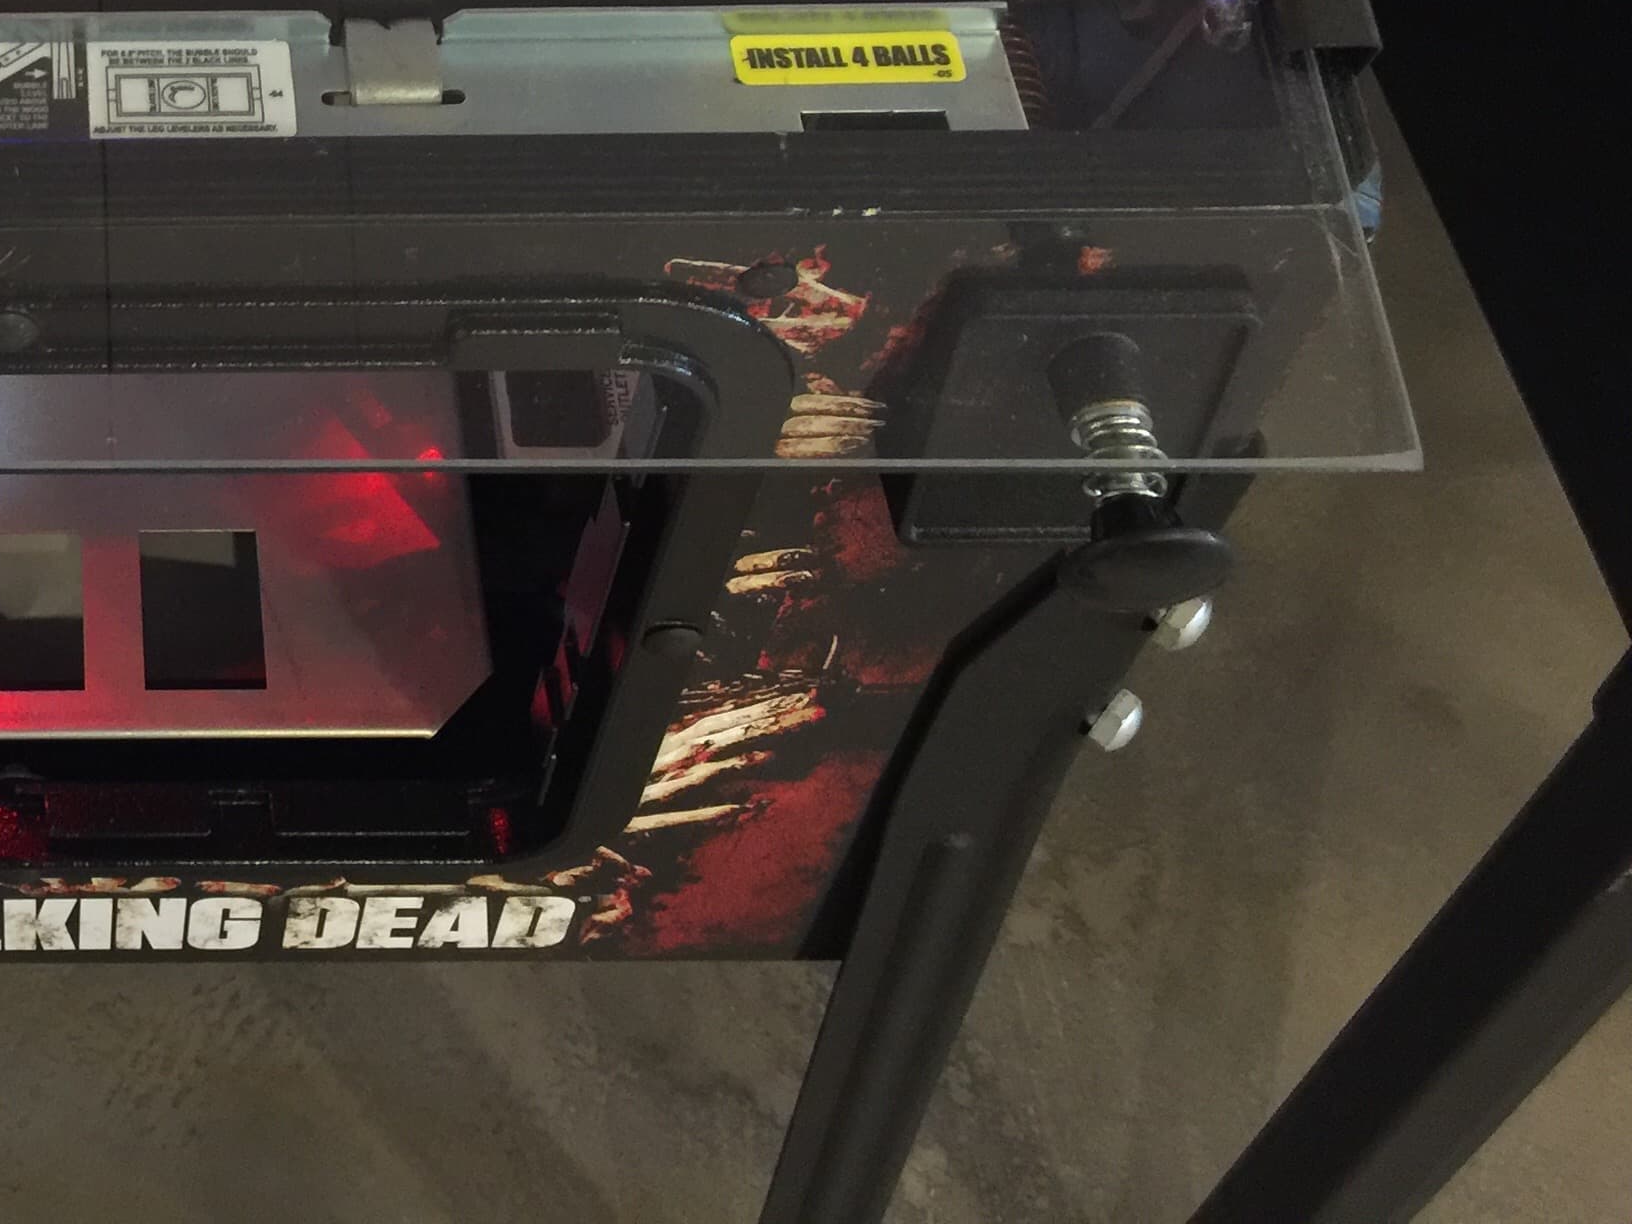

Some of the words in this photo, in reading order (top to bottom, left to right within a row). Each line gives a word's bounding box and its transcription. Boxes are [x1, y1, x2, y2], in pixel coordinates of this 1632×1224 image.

[747, 46, 848, 70] INSTALL
[852, 46, 869, 68] 4
[872, 45, 951, 67] BALLS
[280, 895, 576, 950] DEAD
